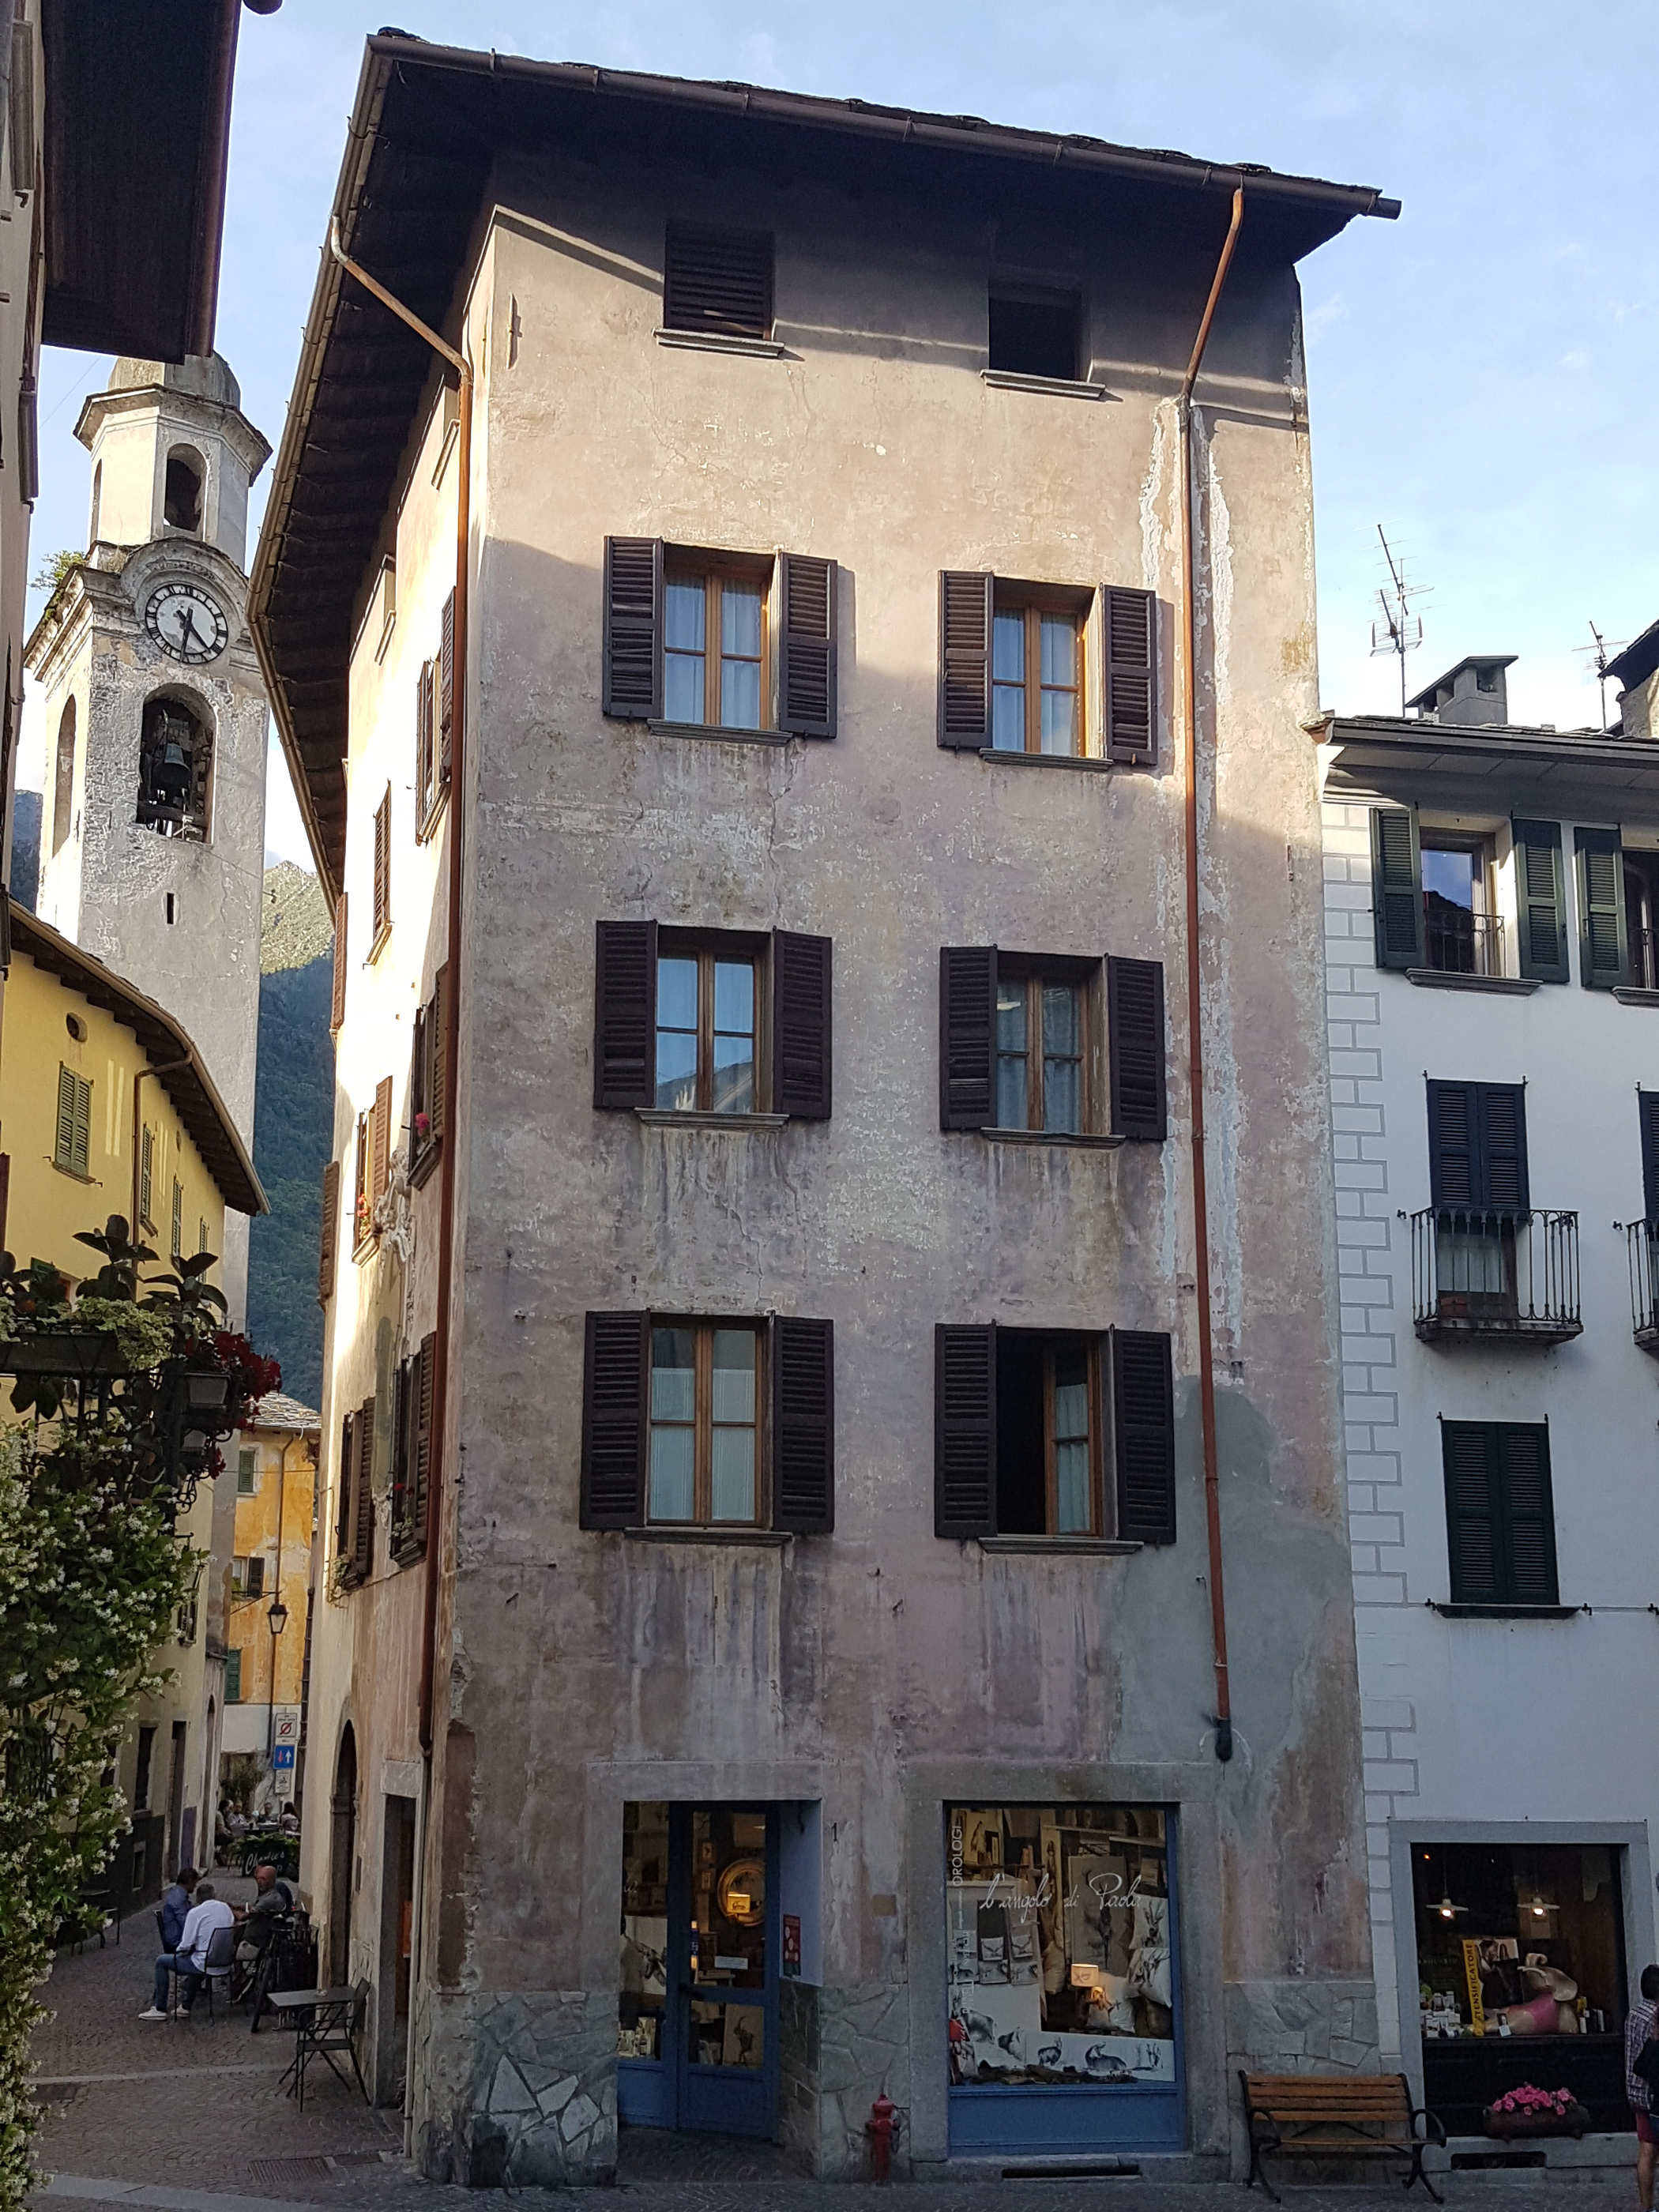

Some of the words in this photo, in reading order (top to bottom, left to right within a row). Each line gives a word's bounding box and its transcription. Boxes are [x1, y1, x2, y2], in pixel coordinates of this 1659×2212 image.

[831, 1823, 837, 1841] 1
[952, 1826, 963, 1887] OROLOGI
[1064, 1884, 1079, 1908] di
[1089, 1872, 1143, 1910] Paola
